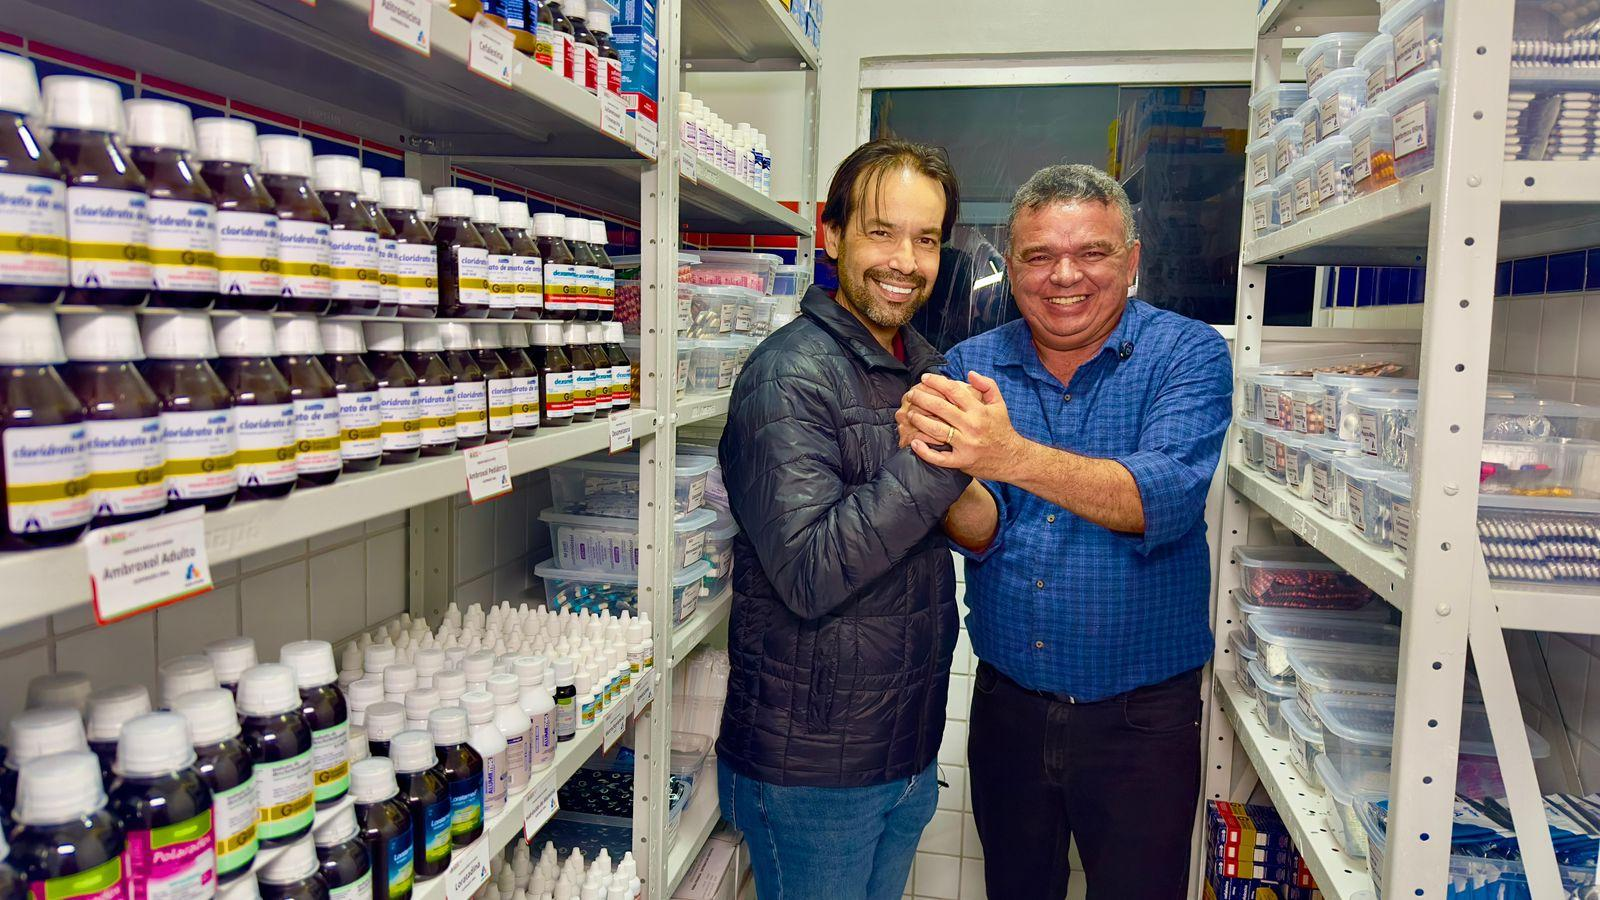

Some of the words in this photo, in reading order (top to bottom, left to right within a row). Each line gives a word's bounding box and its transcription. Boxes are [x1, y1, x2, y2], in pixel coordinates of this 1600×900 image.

[73, 203, 134, 220] cloridrato
[220, 225, 268, 239] cloridrato
[399, 252, 431, 263] cloridrato
[239, 416, 284, 430] cloridrato
[469, 469, 488, 481] Ambroxol
[102, 555, 159, 581] Ambroxol
[161, 547, 196, 566] Adulto
